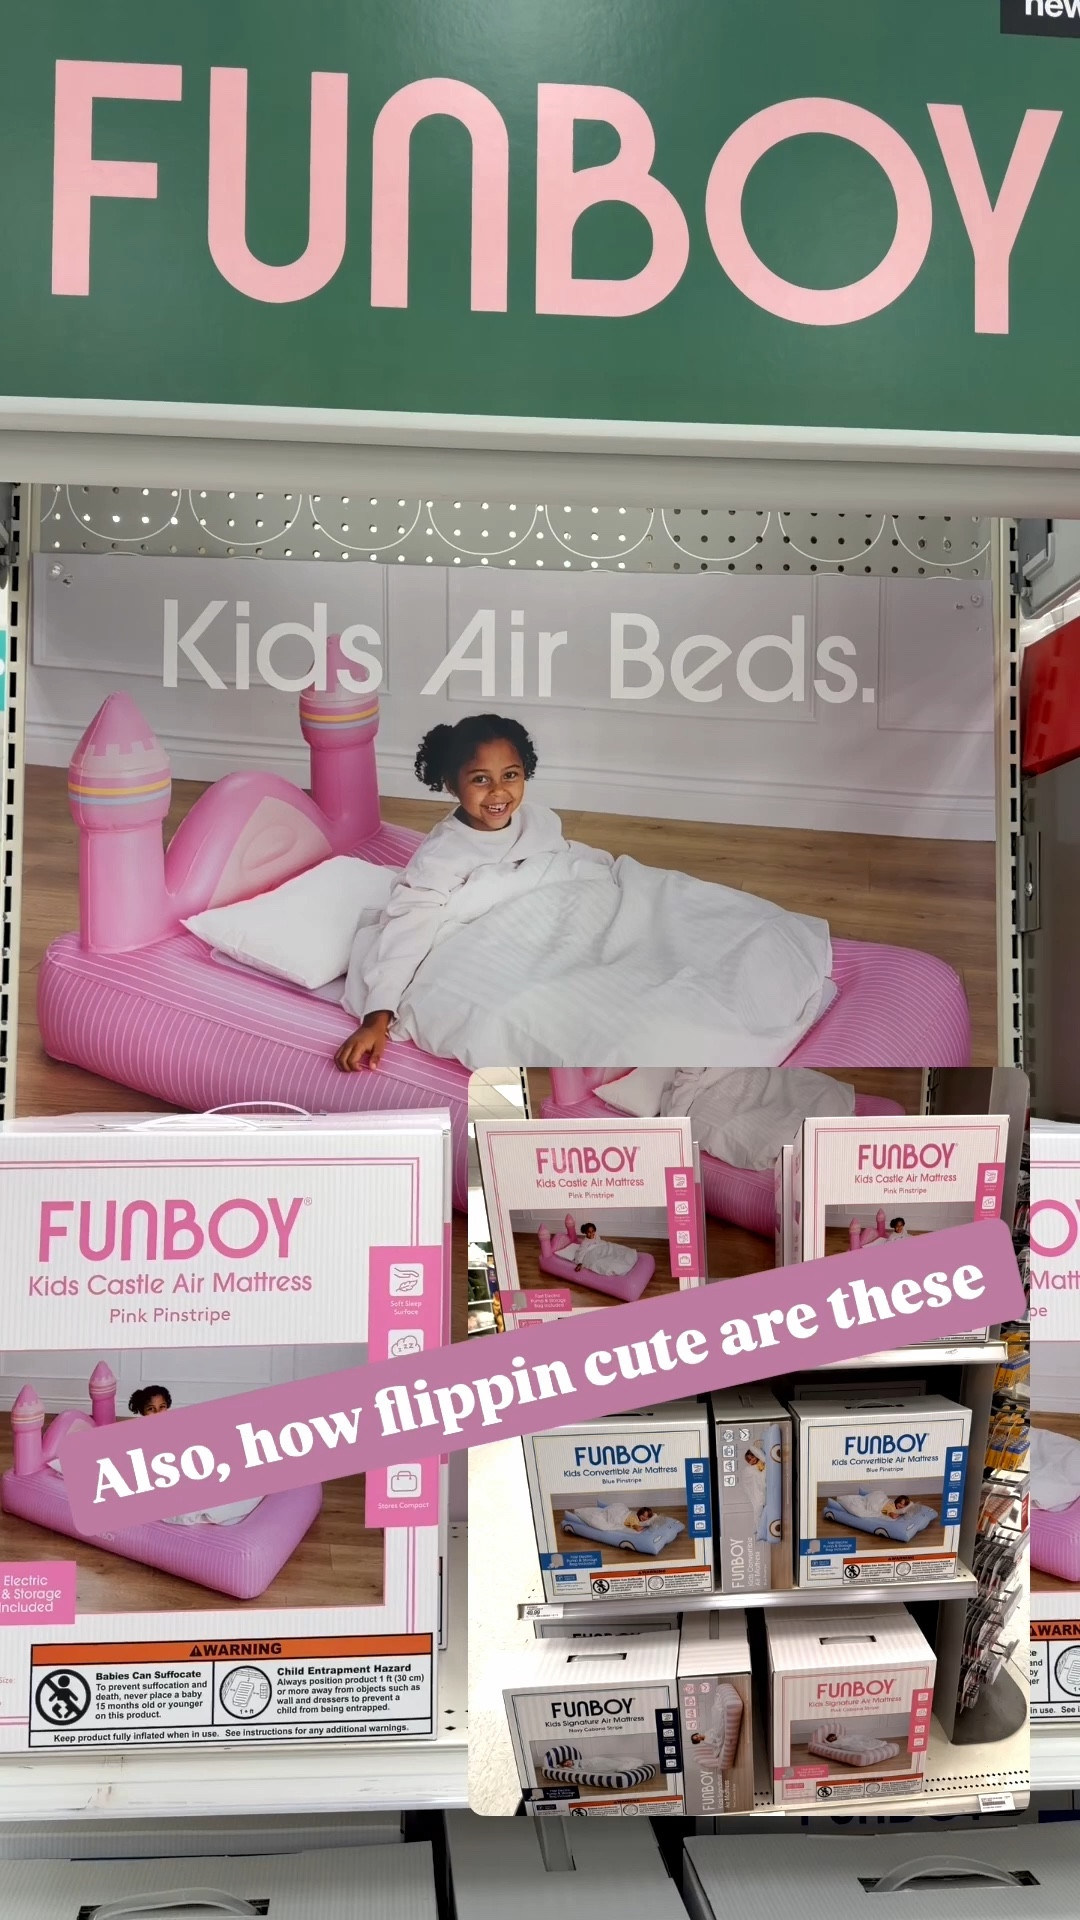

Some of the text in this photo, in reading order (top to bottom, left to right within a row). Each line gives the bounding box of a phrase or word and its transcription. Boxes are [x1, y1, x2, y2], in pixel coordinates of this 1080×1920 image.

[51, 59, 1063, 335] FUNBOY
[163, 598, 875, 705] Kids Air Beds.
[536, 1146, 638, 1174] FUNBOY
[858, 1143, 956, 1170] FUNBOY
[536, 1177, 644, 1188] Kids Castle Air Mattress
[855, 1173, 957, 1184] Kids Castle Air Mattress
[585, 1191, 614, 1199] Pinstripe
[899, 1187, 927, 1195] Pinstripe
[29, 1272, 313, 1296] Kids Castle Air Mattress
[405, 1300, 422, 1308] Sleep
[109, 1307, 230, 1326] Pink Pinstripe
[845, 1433, 927, 1455] FUNBOY
[575, 1444, 663, 1466] FUNBOY
[832, 1458, 848, 1466] Kids
[849, 1457, 893, 1465] Convertible
[908, 1455, 939, 1463] Mattress
[563, 1469, 581, 1477] Kids
[583, 1468, 630, 1477] Convertible
[645, 1466, 678, 1474] Mattress
[730, 1539, 744, 1588] FUNBOY
[4, 1575, 48, 1586] Electric
[1, 1588, 61, 1601] & Storage
[203, 1643, 282, 1657] WARNING
[96, 1670, 201, 1681] Babies Can Suffocate
[277, 1664, 411, 1676] Child Entrapment Hazard
[277, 1678, 307, 1686] Always
[309, 1677, 342, 1685] position
[345, 1676, 376, 1685] product
[395, 1674, 406, 1683] (30
[409, 1674, 424, 1682] cm)
[109, 1683, 140, 1691] prevent
[142, 1682, 189, 1690] suffocation
[311, 1687, 332, 1695] away
[335, 1685, 354, 1693] from
[356, 1684, 386, 1694] objects
[388, 1683, 408, 1692] such
[817, 1679, 895, 1699] FUNBOY
[95, 1693, 121, 1701] death,
[124, 1692, 147, 1700] never
[150, 1691, 172, 1700] place
[182, 1691, 202, 1699] baby
[296, 1696, 311, 1704] and
[313, 1695, 349, 1703] dressers
[362, 1694, 393, 1702] prevent
[872, 1696, 902, 1704] Mattress
[169, 1700, 203, 1709] younger
[277, 1704, 390, 1715] child from being entrapped.
[551, 1698, 634, 1718] FUNBOY
[126, 1711, 161, 1720] product.
[545, 1720, 561, 1728] Kids
[563, 1719, 599, 1728] Signature
[54, 1734, 76, 1743] Keep
[78, 1733, 111, 1743] product
[113, 1732, 131, 1742] fully
[133, 1732, 165, 1740] inflated
[192, 1730, 200, 1738] in
[225, 1729, 241, 1737] See
[243, 1727, 293, 1736] instructions
[295, 1726, 306, 1734] for
[308, 1727, 323, 1736] any
[326, 1725, 367, 1734] additional
[369, 1724, 409, 1733] warnings.
[700, 1770, 715, 1811] FUNBOY
